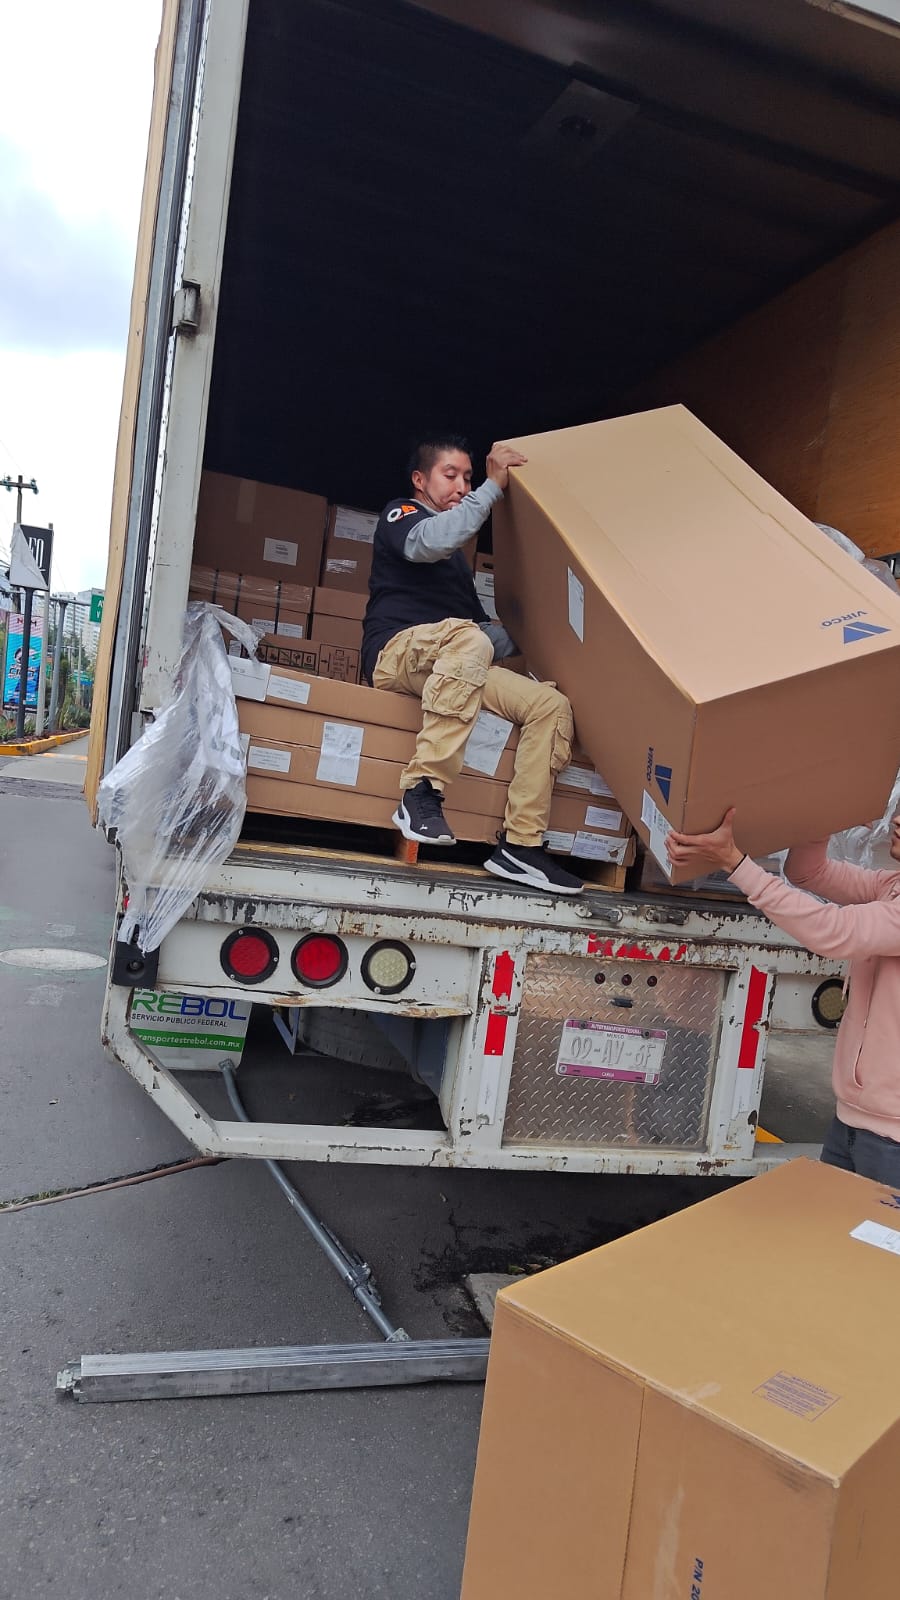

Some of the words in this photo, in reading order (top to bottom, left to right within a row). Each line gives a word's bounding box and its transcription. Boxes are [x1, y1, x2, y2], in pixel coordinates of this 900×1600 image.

[822, 610, 868, 627] VIRCO
[646, 746, 654, 782] VIRCO
[131, 990, 247, 1020] REBOL
[131, 1013, 164, 1022] SERVICIO
[165, 1016, 195, 1025] PUBLICO
[197, 1019, 228, 1028] FEDERAL
[626, 1027, 642, 1035] FEDERA
[138, 1034, 241, 1049] ransportestrebol.com.mx
[693, 1557, 704, 1583] P/N
